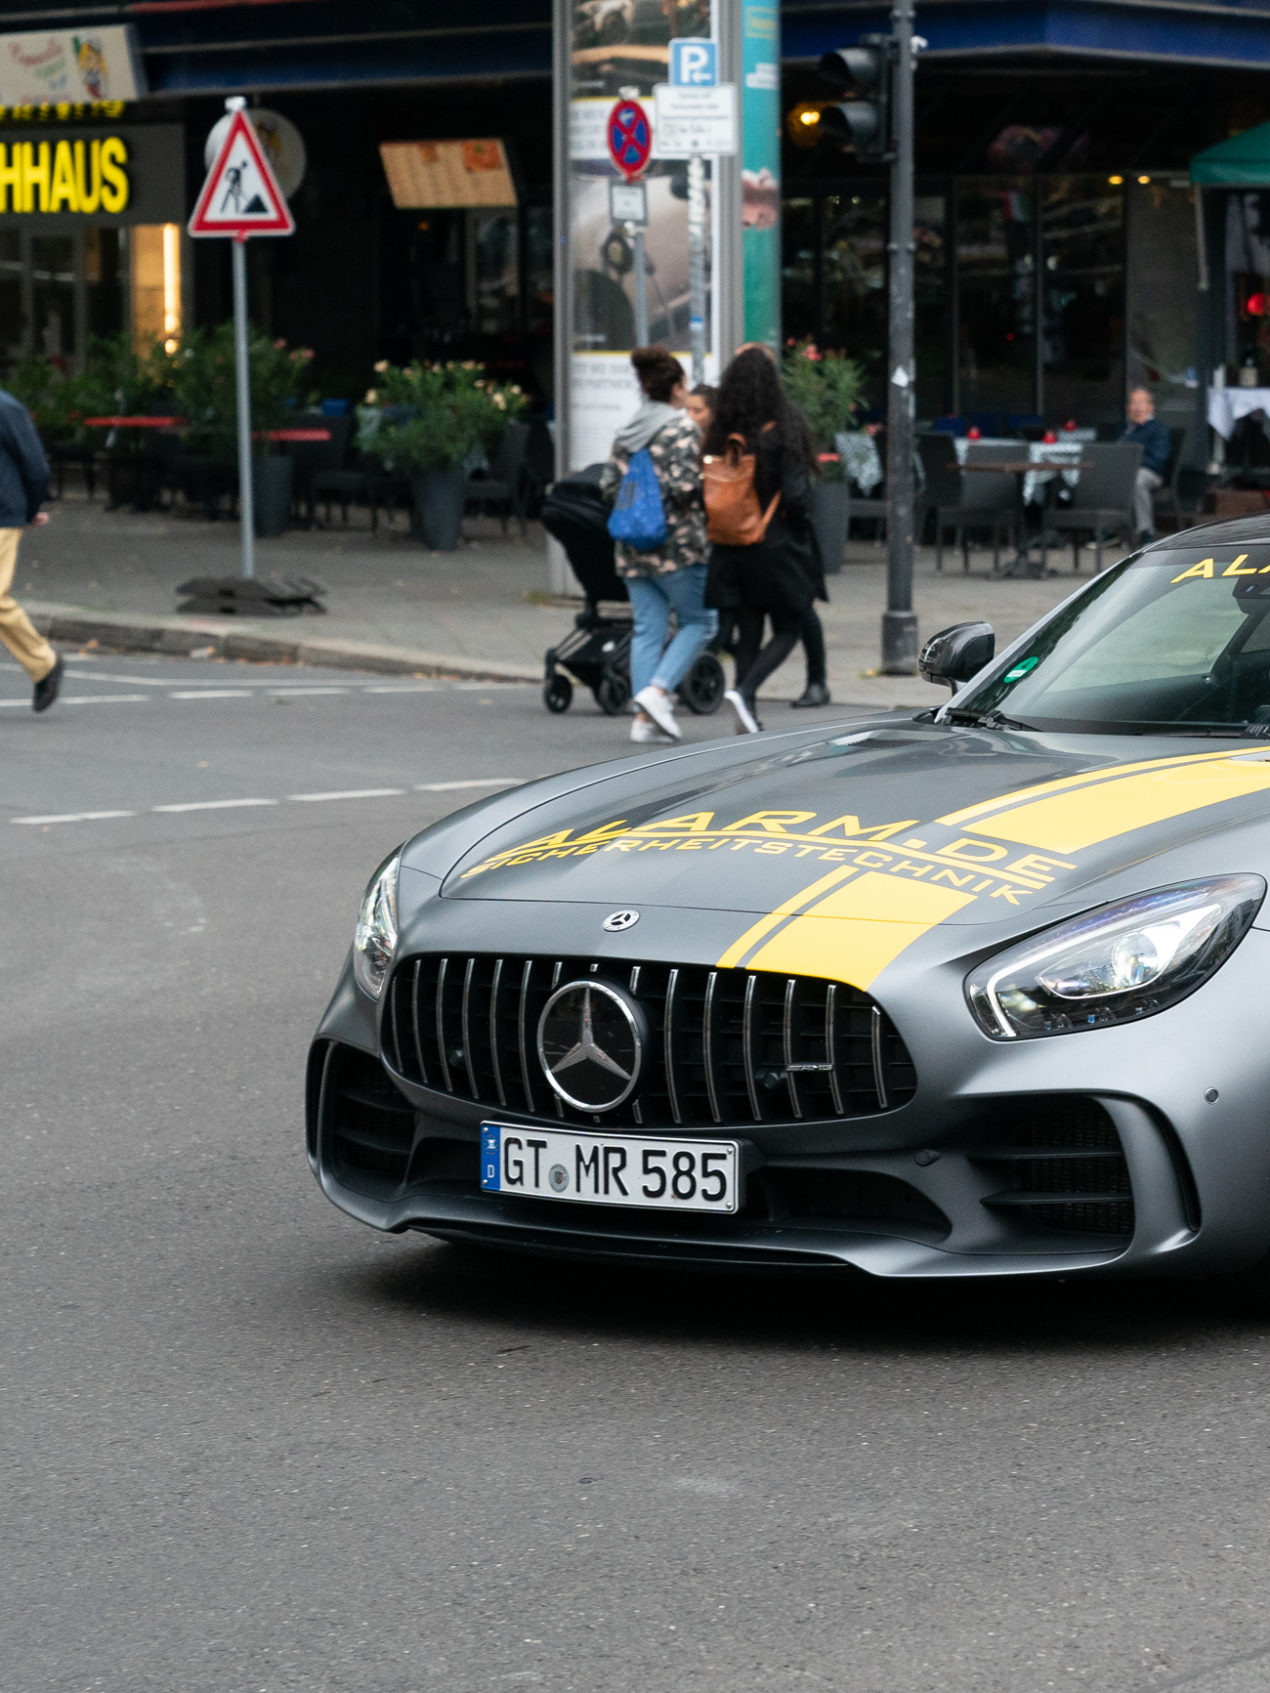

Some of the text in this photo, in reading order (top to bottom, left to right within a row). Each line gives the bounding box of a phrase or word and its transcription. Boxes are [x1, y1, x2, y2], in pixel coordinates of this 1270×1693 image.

[680, 45, 709, 84] P
[0, 136, 130, 214] HHAUS
[460, 838, 1034, 906] SICHERHEITSTECHNIK
[484, 810, 1078, 882] ALARM.DE
[487, 1164, 496, 1179] D
[503, 1136, 728, 1202] GT MR 585
